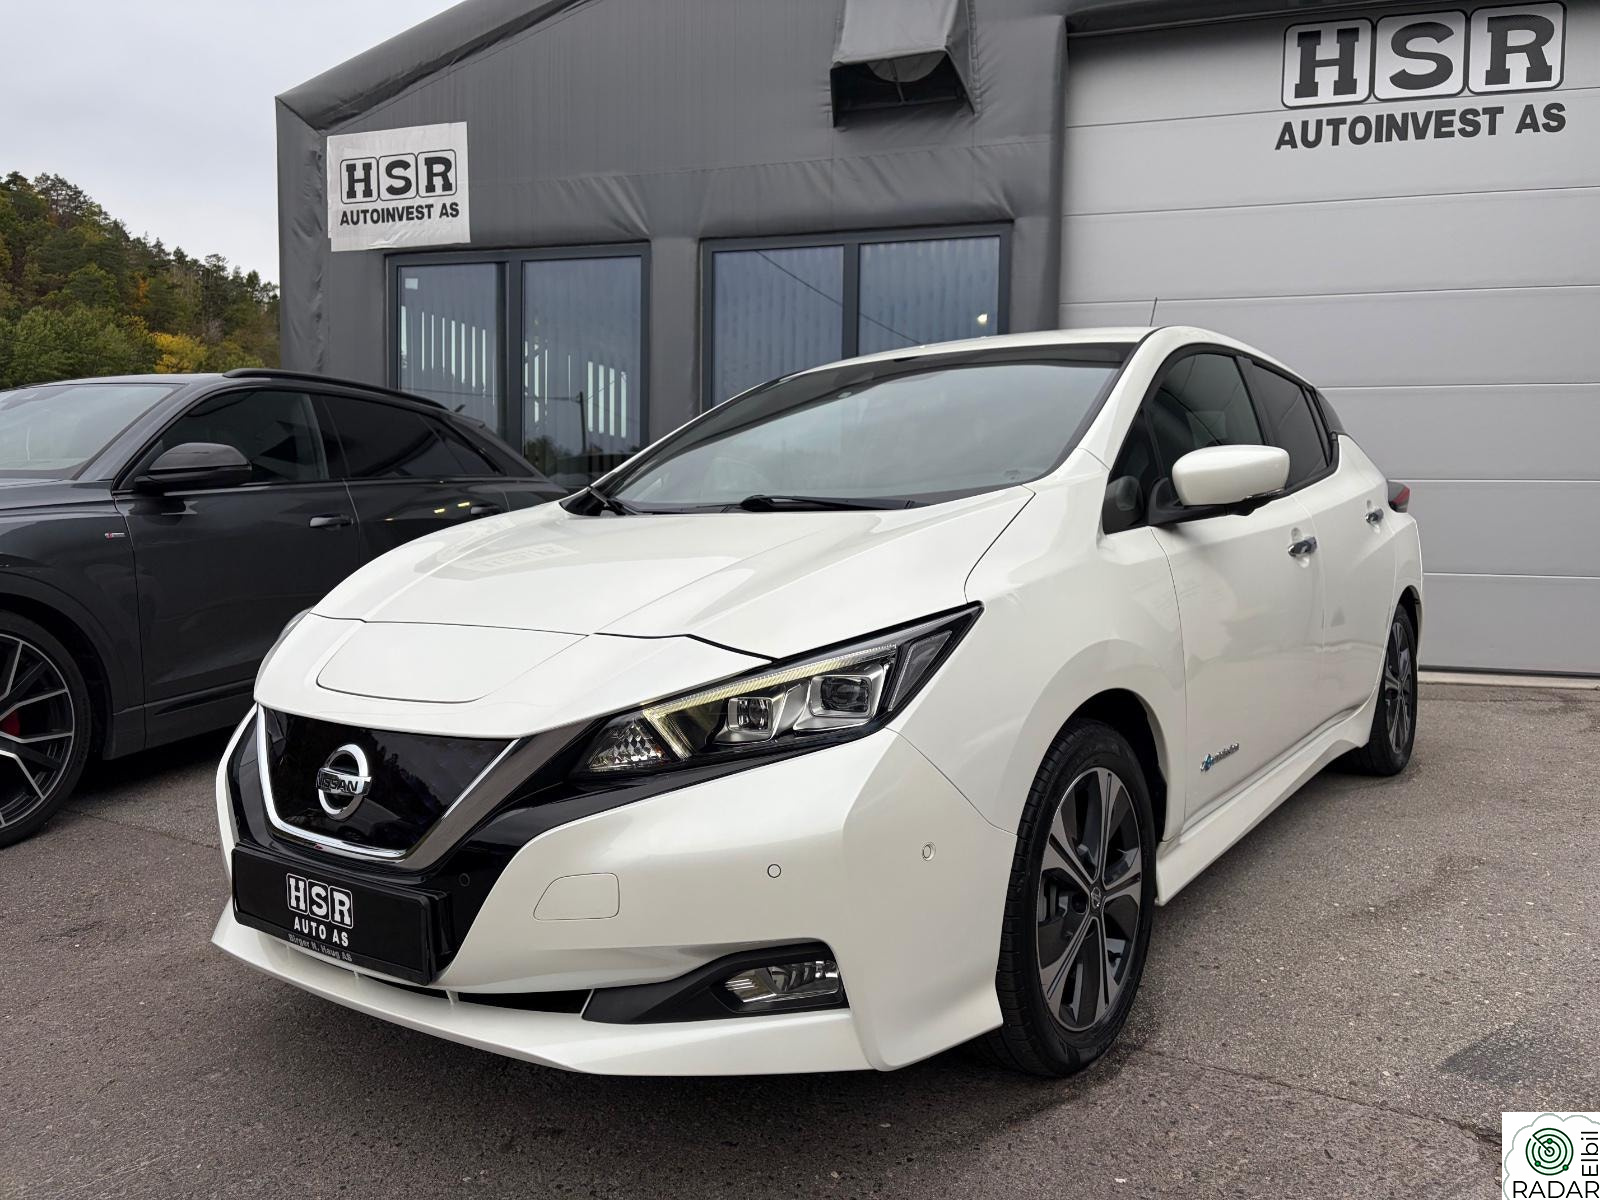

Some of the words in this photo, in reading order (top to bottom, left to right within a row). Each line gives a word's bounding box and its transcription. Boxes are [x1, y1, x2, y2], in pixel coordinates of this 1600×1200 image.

[1293, 13, 1556, 99] HSR
[1274, 106, 1504, 150] AUTOINVEST
[1515, 102, 1567, 134] AS
[345, 156, 453, 199] HSR
[339, 204, 434, 226] AUTOINVEST
[439, 202, 459, 218] AS
[289, 877, 351, 925] HSR
[293, 916, 327, 940] AUTO
[332, 929, 349, 947] AS
